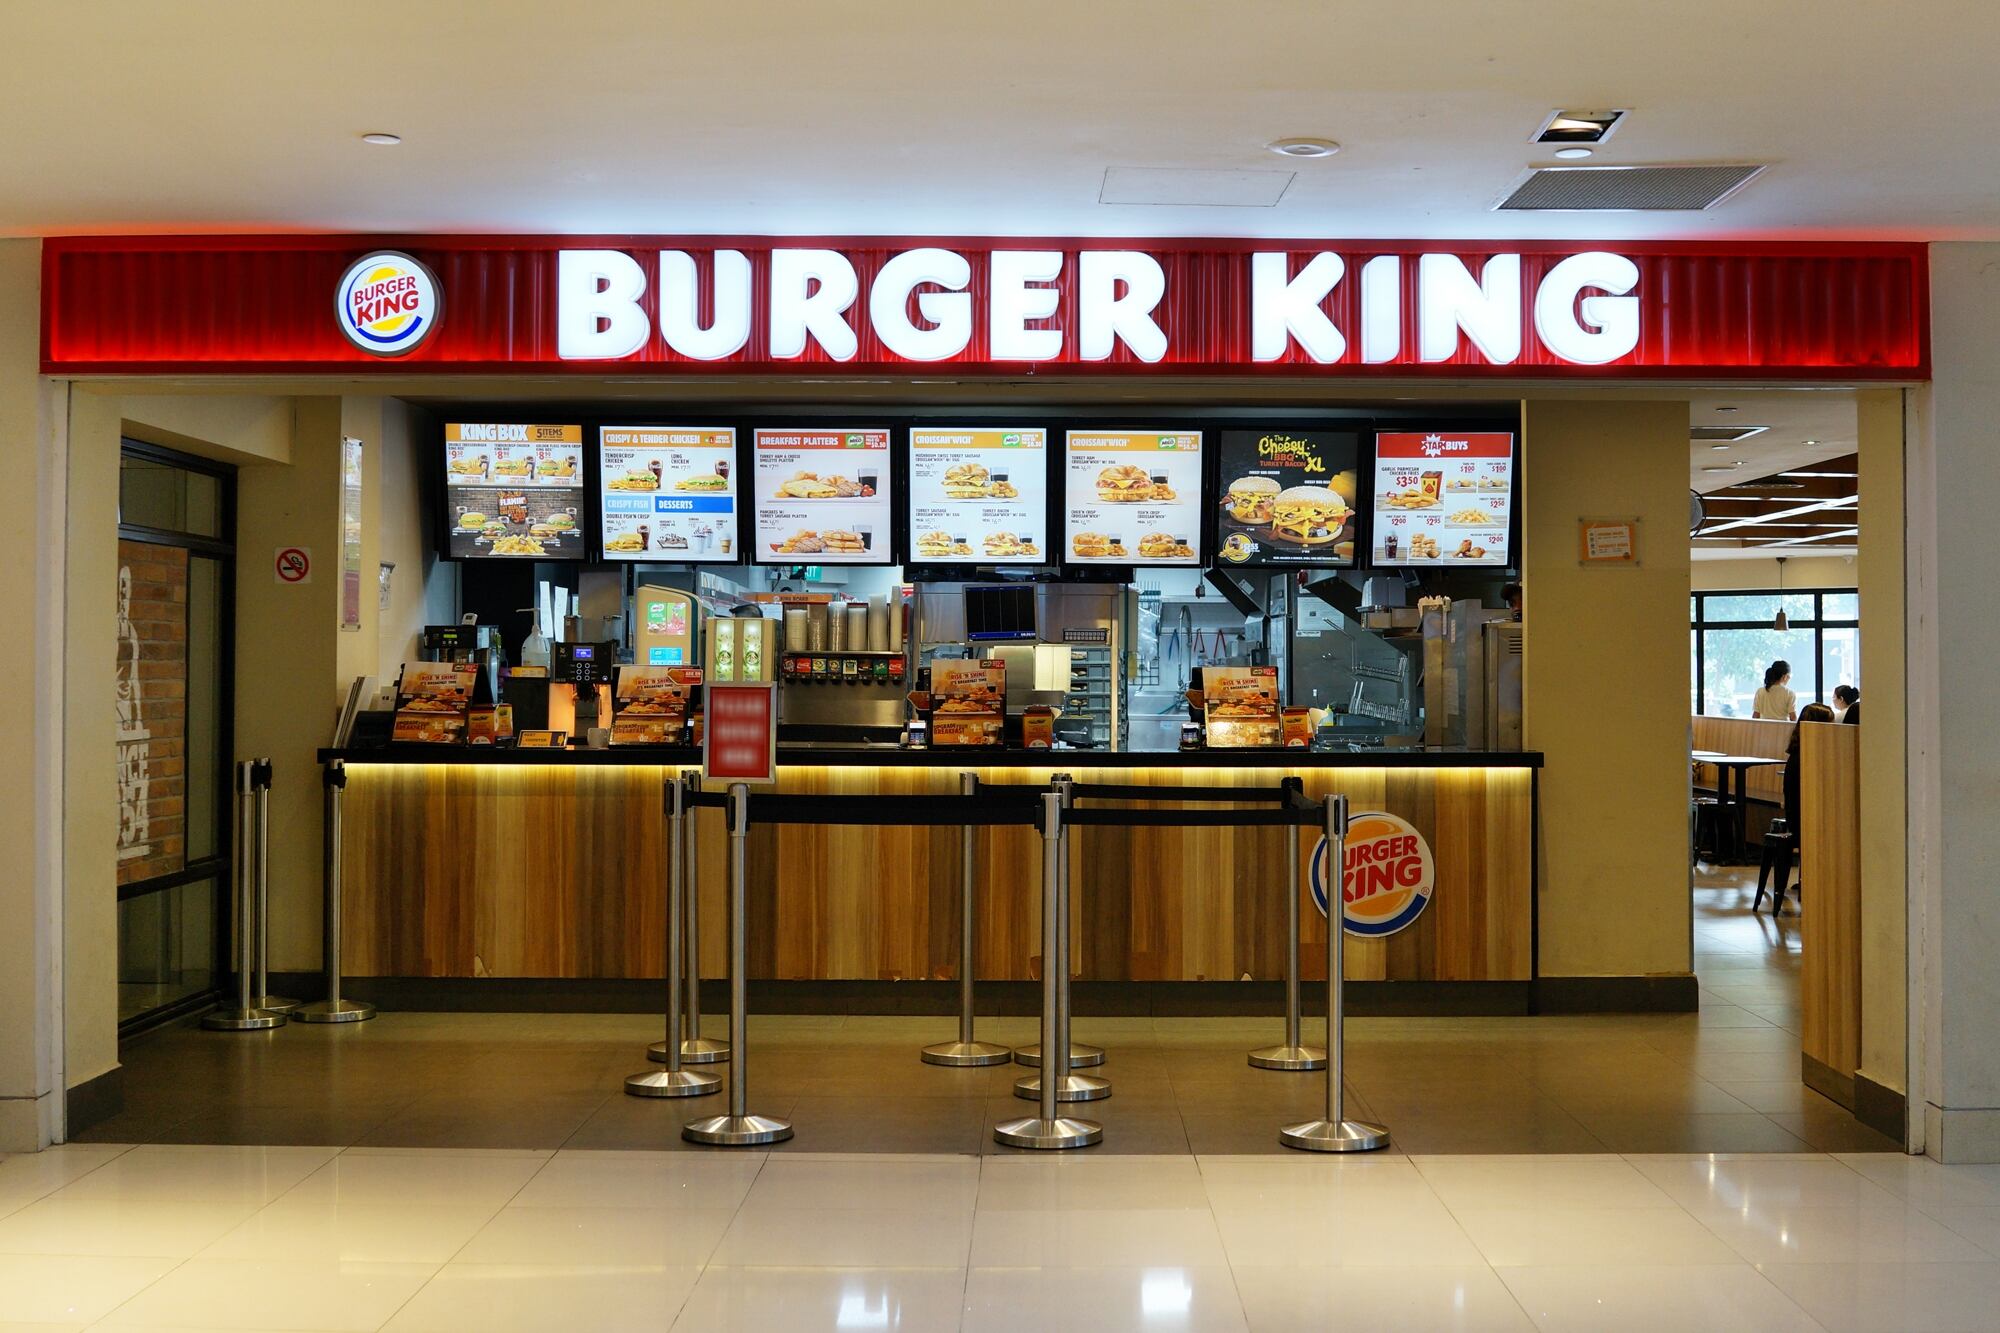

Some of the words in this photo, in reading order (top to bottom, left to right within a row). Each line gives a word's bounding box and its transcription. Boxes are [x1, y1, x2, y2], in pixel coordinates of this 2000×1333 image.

[354, 276, 416, 306] BURGER
[357, 290, 419, 326] KING
[558, 248, 1167, 363] BURGER
[1252, 251, 1640, 365] KING
[461, 424, 496, 441] KING
[497, 425, 528, 441] BOX
[606, 434, 631, 443] CRISPY
[633, 434, 639, 443] &
[640, 435, 668, 443] TENDER
[670, 436, 700, 444] CHICKEN
[760, 437, 801, 446] BREAKFAST
[803, 437, 839, 446] PLATTERS
[1421, 440, 1445, 450] STAR
[1446, 441, 1468, 450] BUYS
[1304, 457, 1326, 472] XL
[608, 500, 632, 509] CRISPY
[634, 501, 648, 509] FISH
[659, 500, 693, 509] DESSERTS
[1325, 835, 1418, 879] URGER
